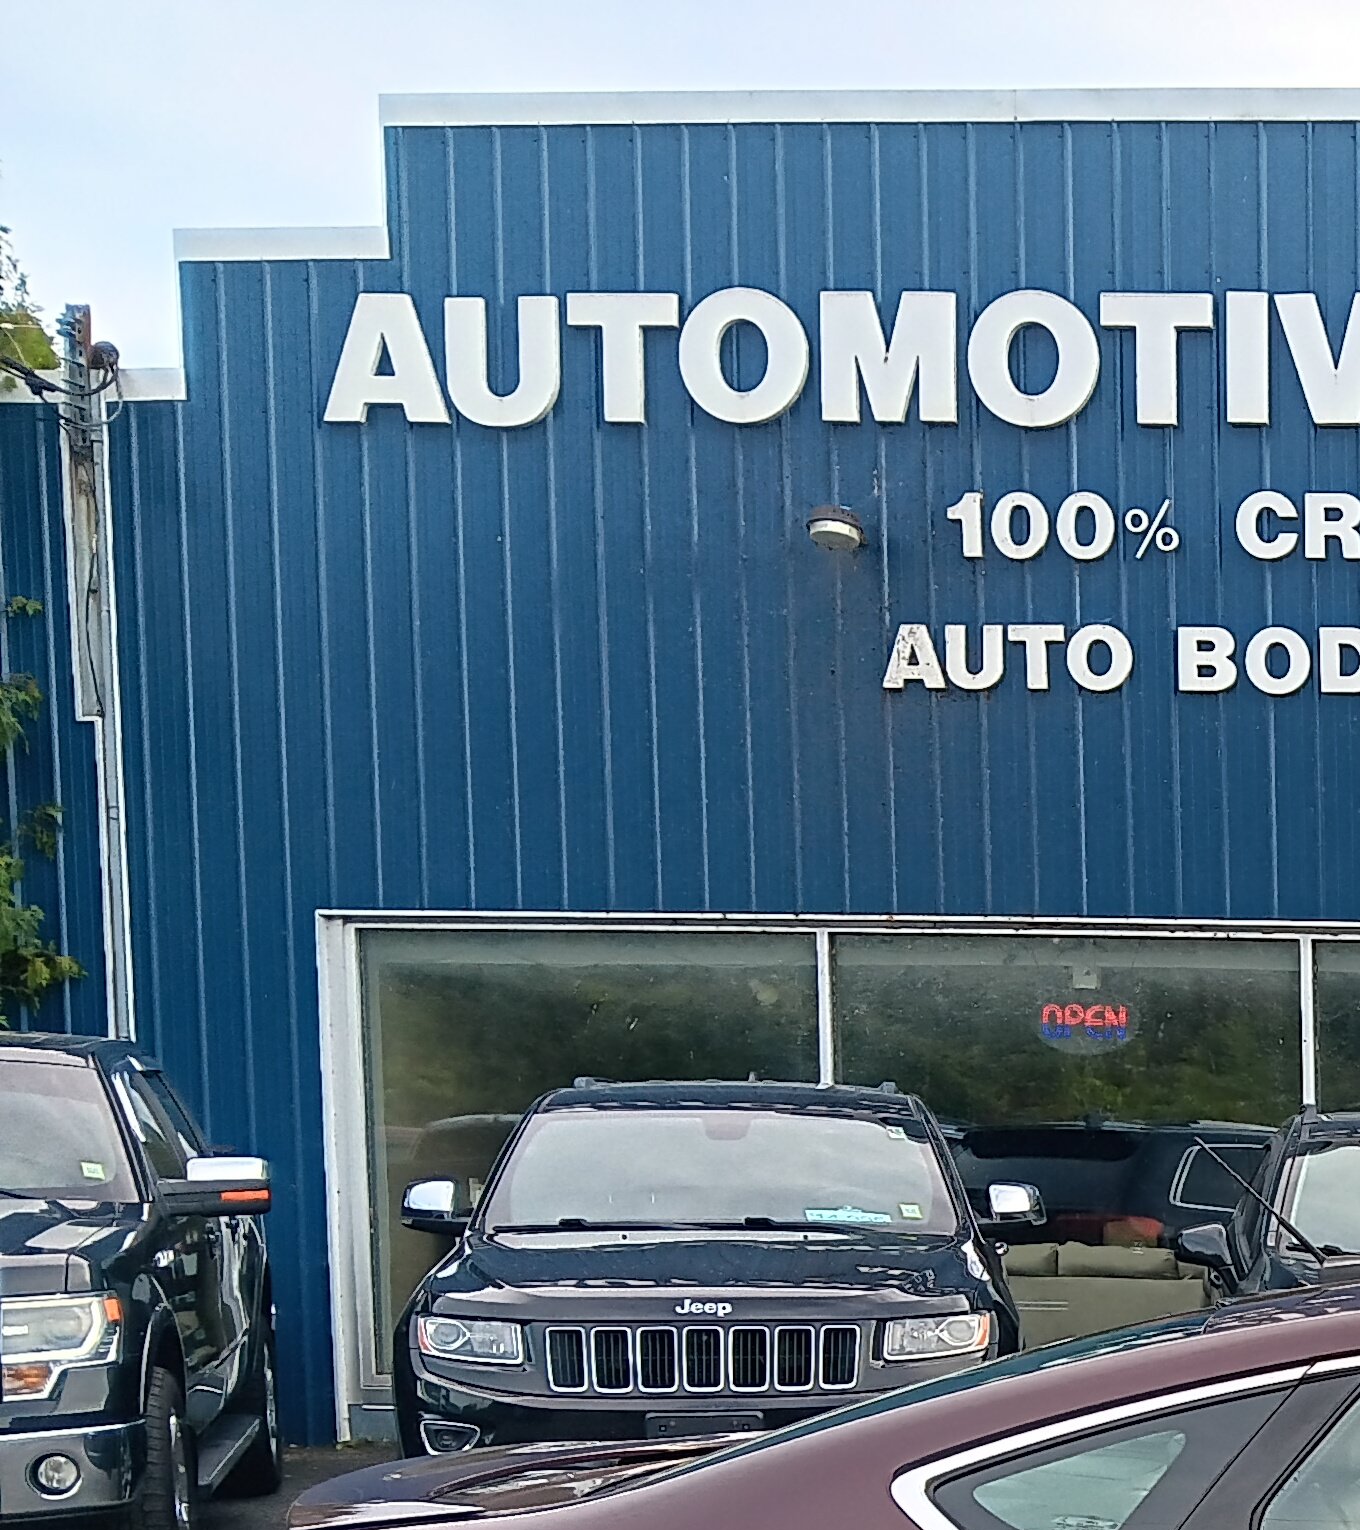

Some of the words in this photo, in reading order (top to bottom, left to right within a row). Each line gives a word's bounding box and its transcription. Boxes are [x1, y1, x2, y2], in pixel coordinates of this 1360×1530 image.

[946, 491, 1181, 561] 100%
[882, 623, 1134, 693] AUTO
[1042, 1003, 1129, 1040] OPEN
[675, 1298, 733, 1318] Jeep
